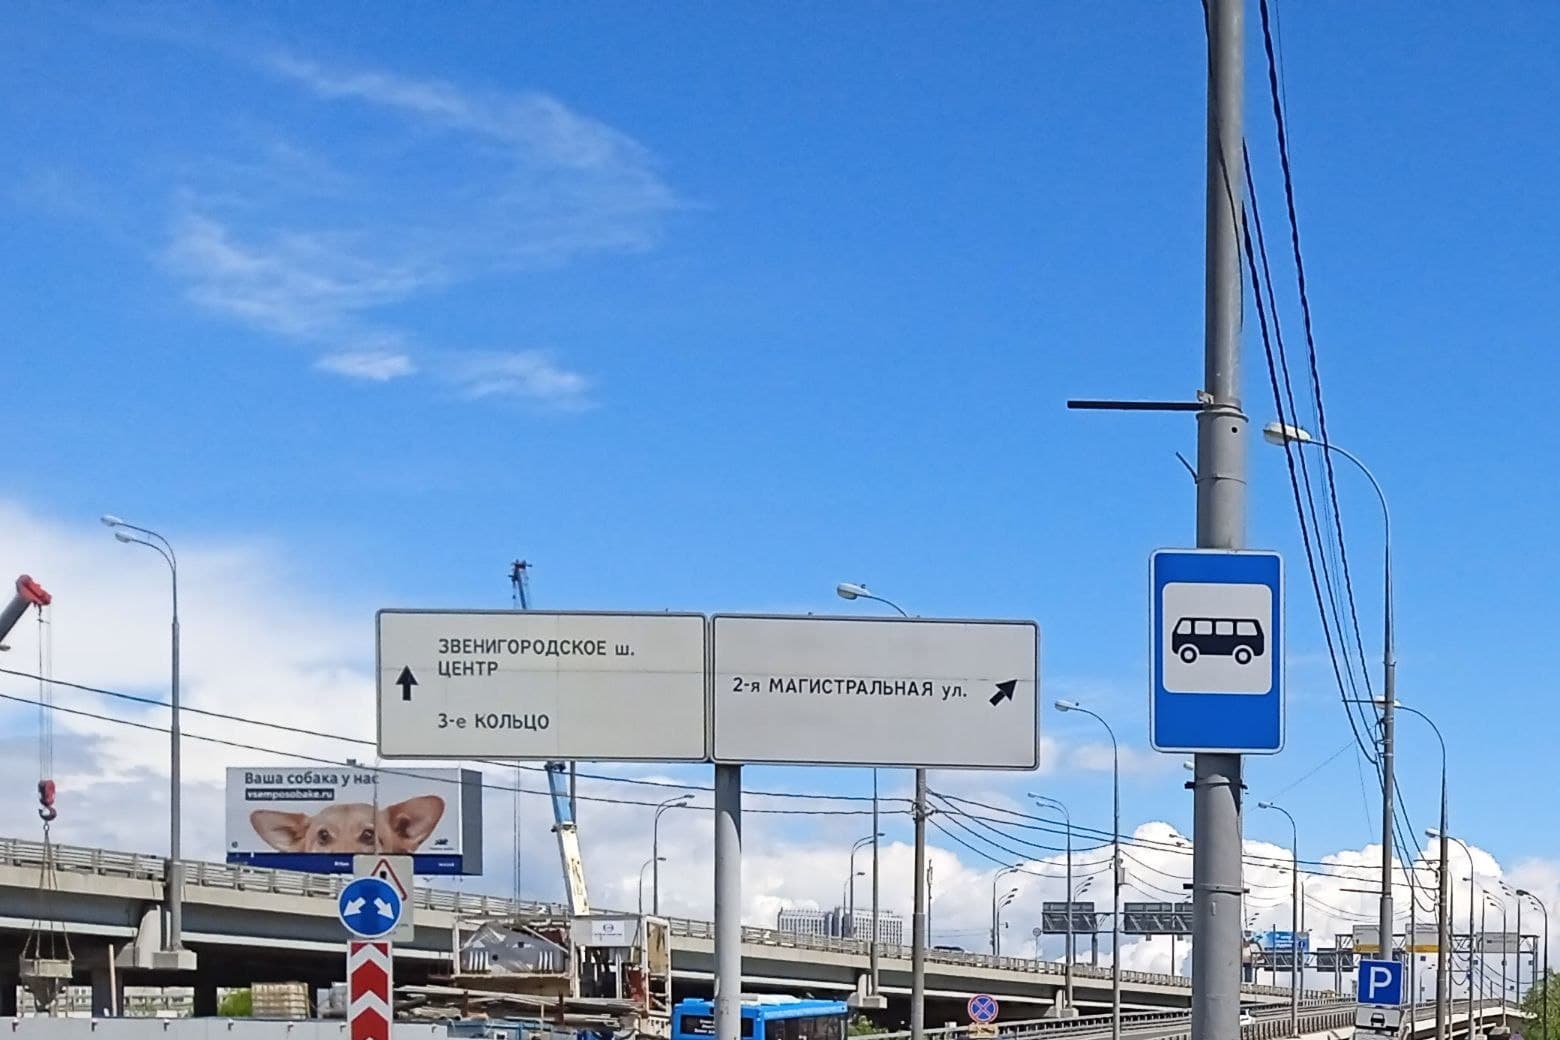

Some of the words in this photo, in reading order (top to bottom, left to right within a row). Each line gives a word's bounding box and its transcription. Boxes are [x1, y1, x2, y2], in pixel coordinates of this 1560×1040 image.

[437, 638, 608, 658] ЗВЕНИГОРОДСКОЕ
[615, 645, 635, 658] ш.
[437, 660, 500, 680] ЦЕНТР
[732, 676, 760, 695] 2-я
[768, 678, 933, 698] МАГИСТРАЛЬНАЯ
[941, 684, 968, 701] ул.
[437, 713, 467, 730] 3-е
[474, 712, 550, 733] КОЛЬЦО
[244, 772, 283, 785] Ваша
[286, 771, 338, 785] собака
[341, 774, 350, 787] у
[353, 773, 379, 785] нас
[247, 789, 333, 800] vsemposobake.ru
[1368, 966, 1393, 999] P
